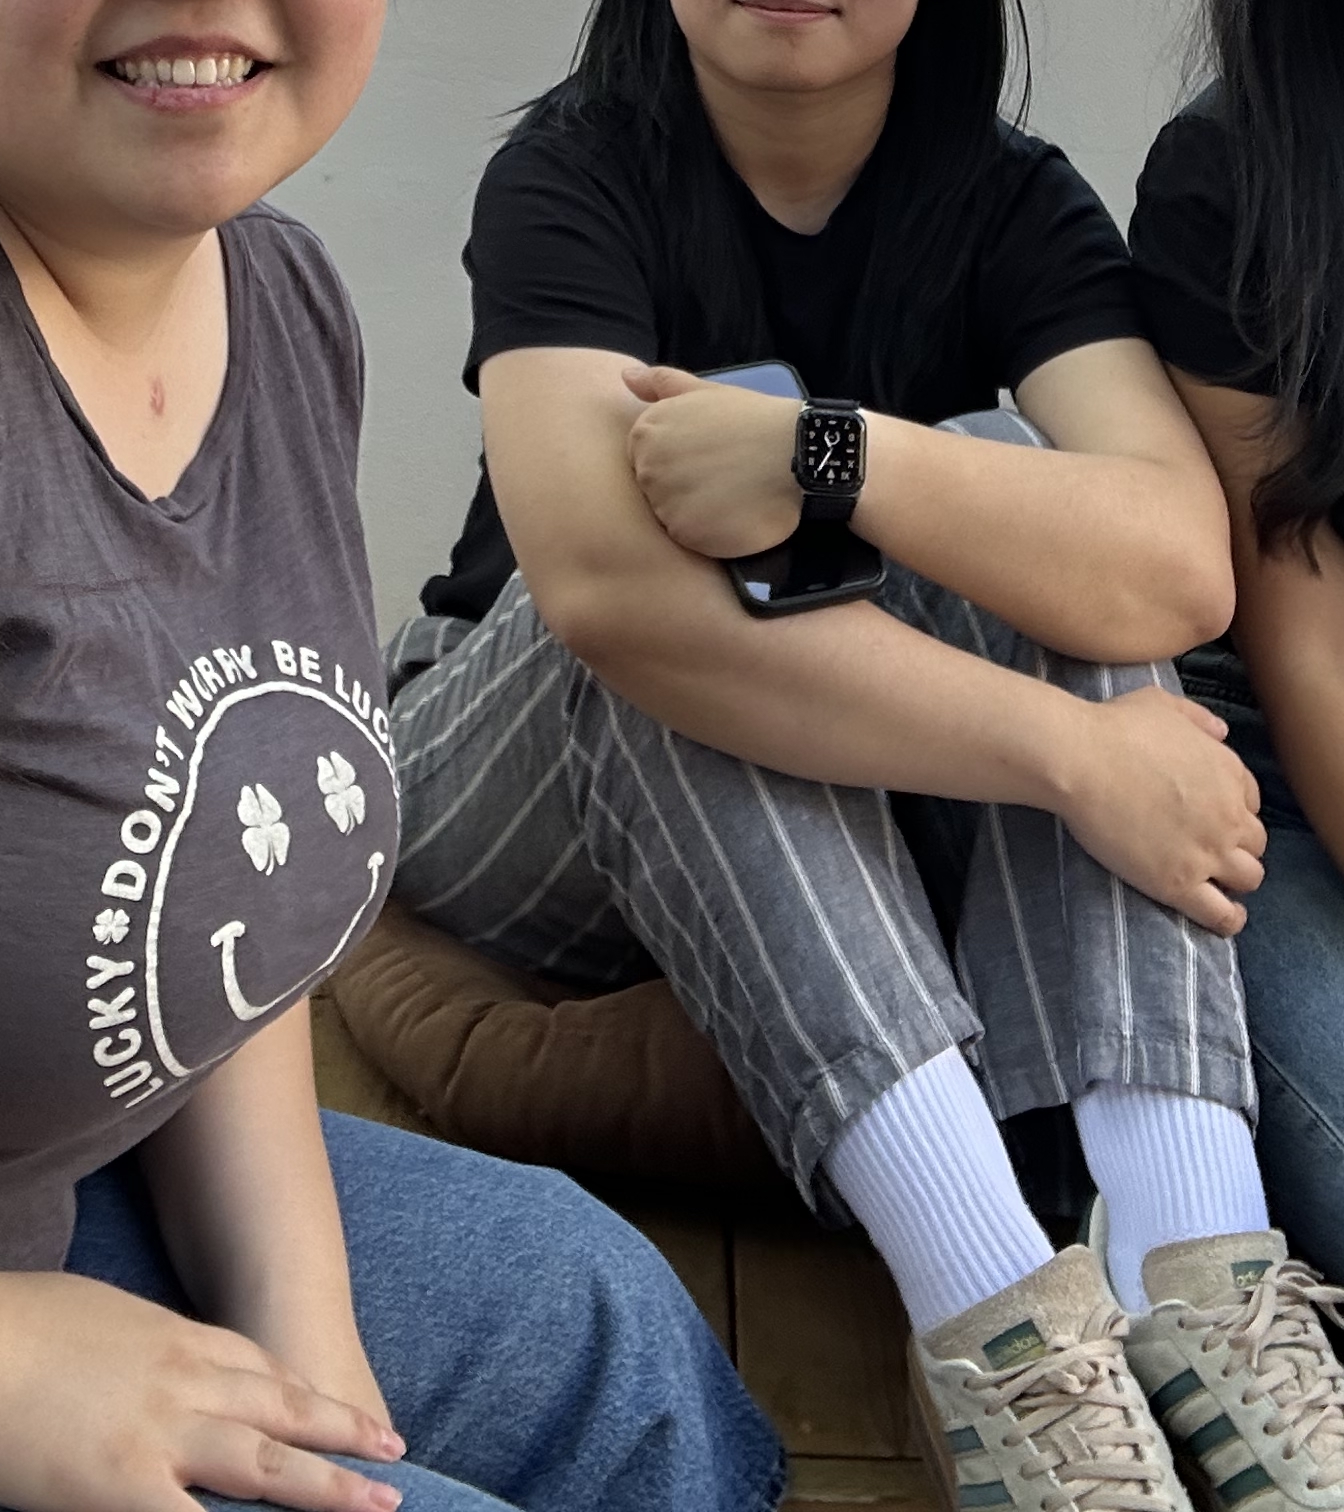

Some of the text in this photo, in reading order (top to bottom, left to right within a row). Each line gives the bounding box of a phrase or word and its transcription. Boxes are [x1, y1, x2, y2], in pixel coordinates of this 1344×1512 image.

[101, 725, 185, 902] DON'T
[272, 639, 323, 683] BE
[86, 955, 164, 1109] LUCKY
